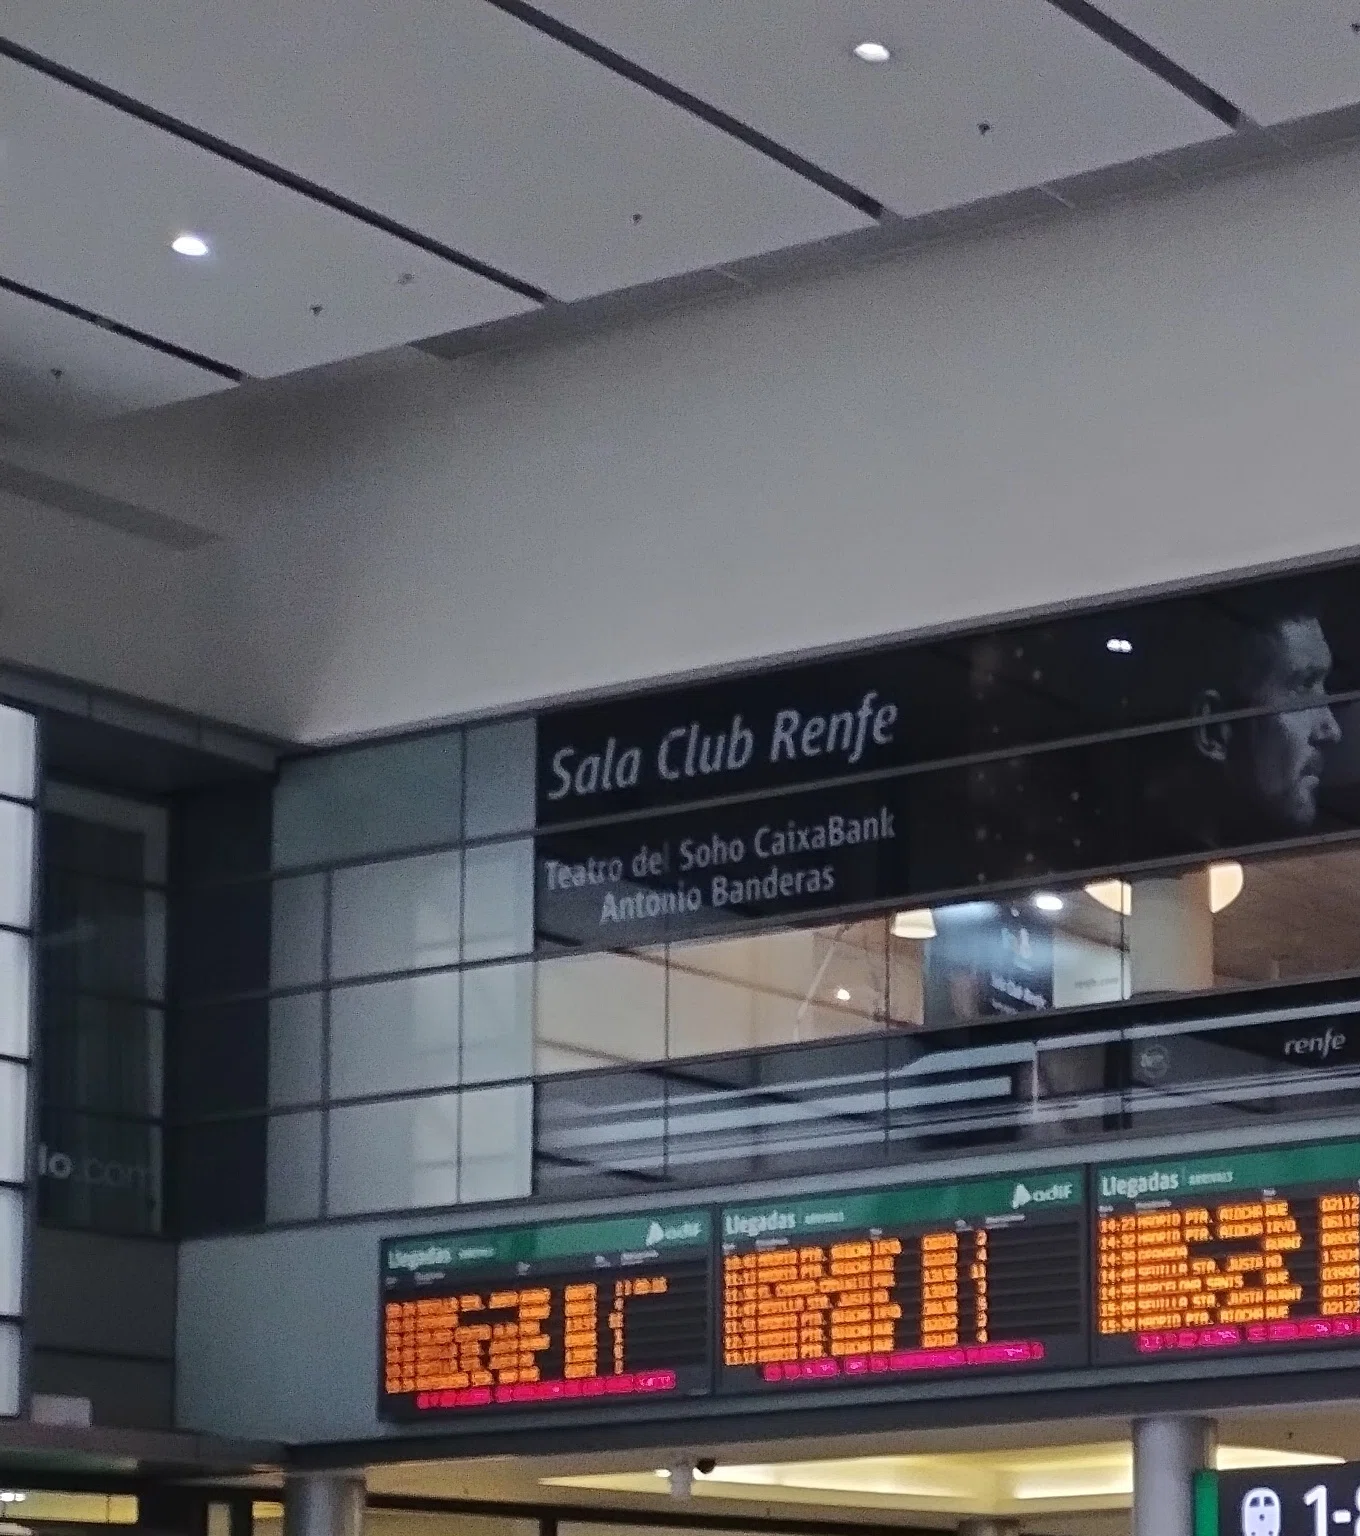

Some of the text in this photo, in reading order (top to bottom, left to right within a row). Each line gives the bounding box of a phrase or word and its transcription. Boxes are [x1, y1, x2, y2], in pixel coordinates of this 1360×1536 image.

[548, 690, 899, 800] Sala Club Renfe
[544, 805, 896, 892] Teatro del Soho CaixaBank
[600, 864, 835, 925] Antonio Banderas
[1285, 1027, 1345, 1059] renfe
[1102, 1172, 1178, 1198] Llegadas
